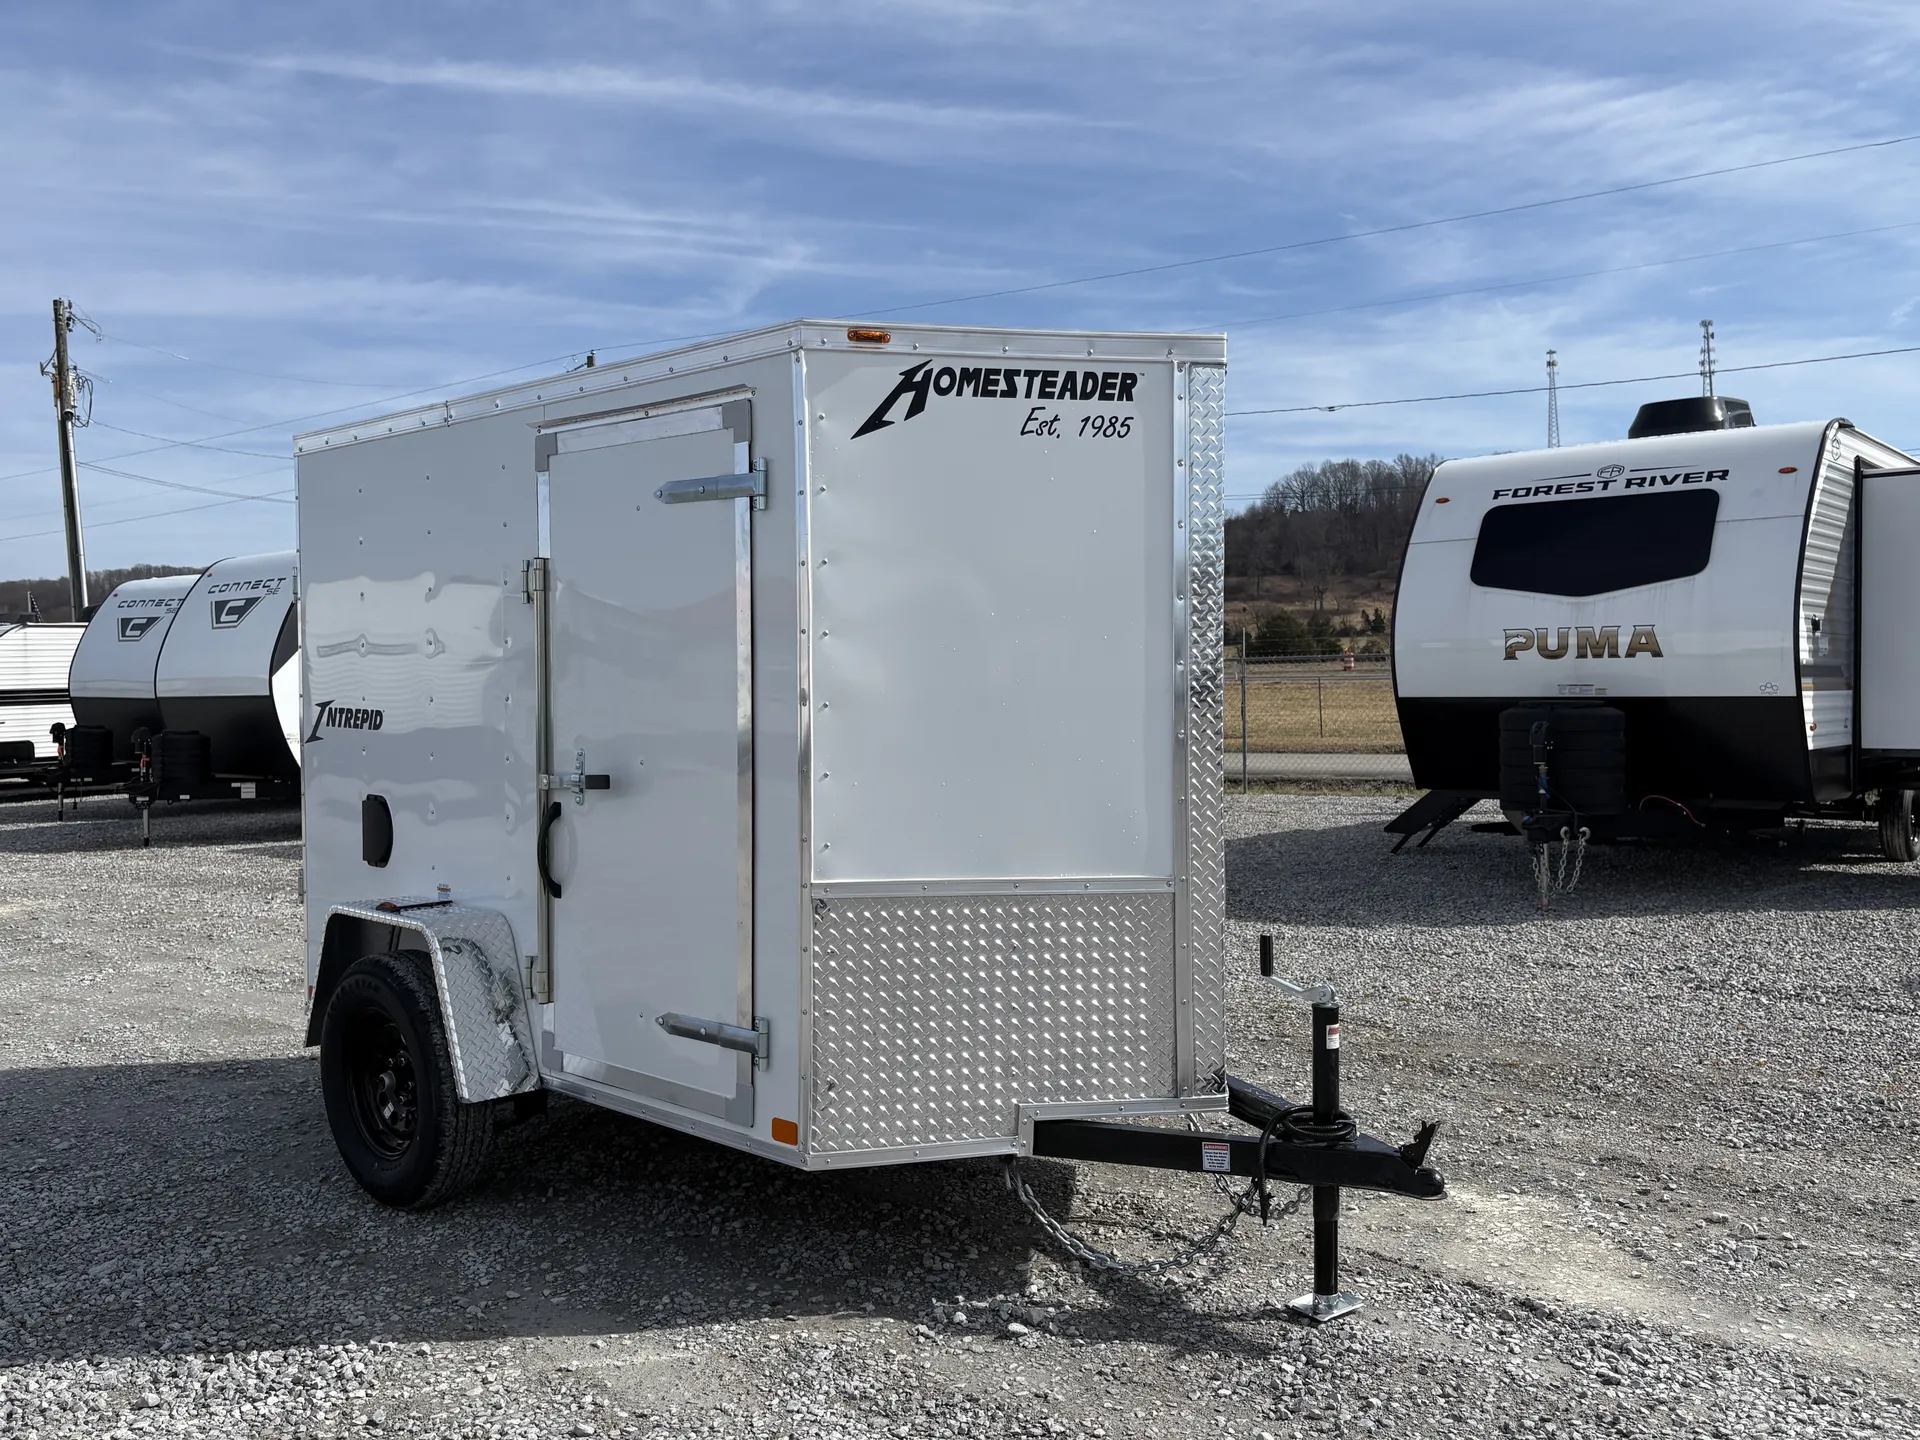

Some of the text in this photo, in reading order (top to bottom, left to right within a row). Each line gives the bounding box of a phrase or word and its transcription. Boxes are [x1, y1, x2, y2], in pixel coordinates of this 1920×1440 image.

[850, 359, 1139, 439] HOMESTEADER
[1020, 407, 1134, 439] Est. 1985
[1492, 469, 1730, 500] FOREST RIVER
[208, 577, 286, 595] CONNECT
[265, 587, 281, 596] SE
[117, 598, 185, 609] CONNECT
[1503, 625, 1664, 660] PUMA
[305, 700, 384, 744] INTREPID
